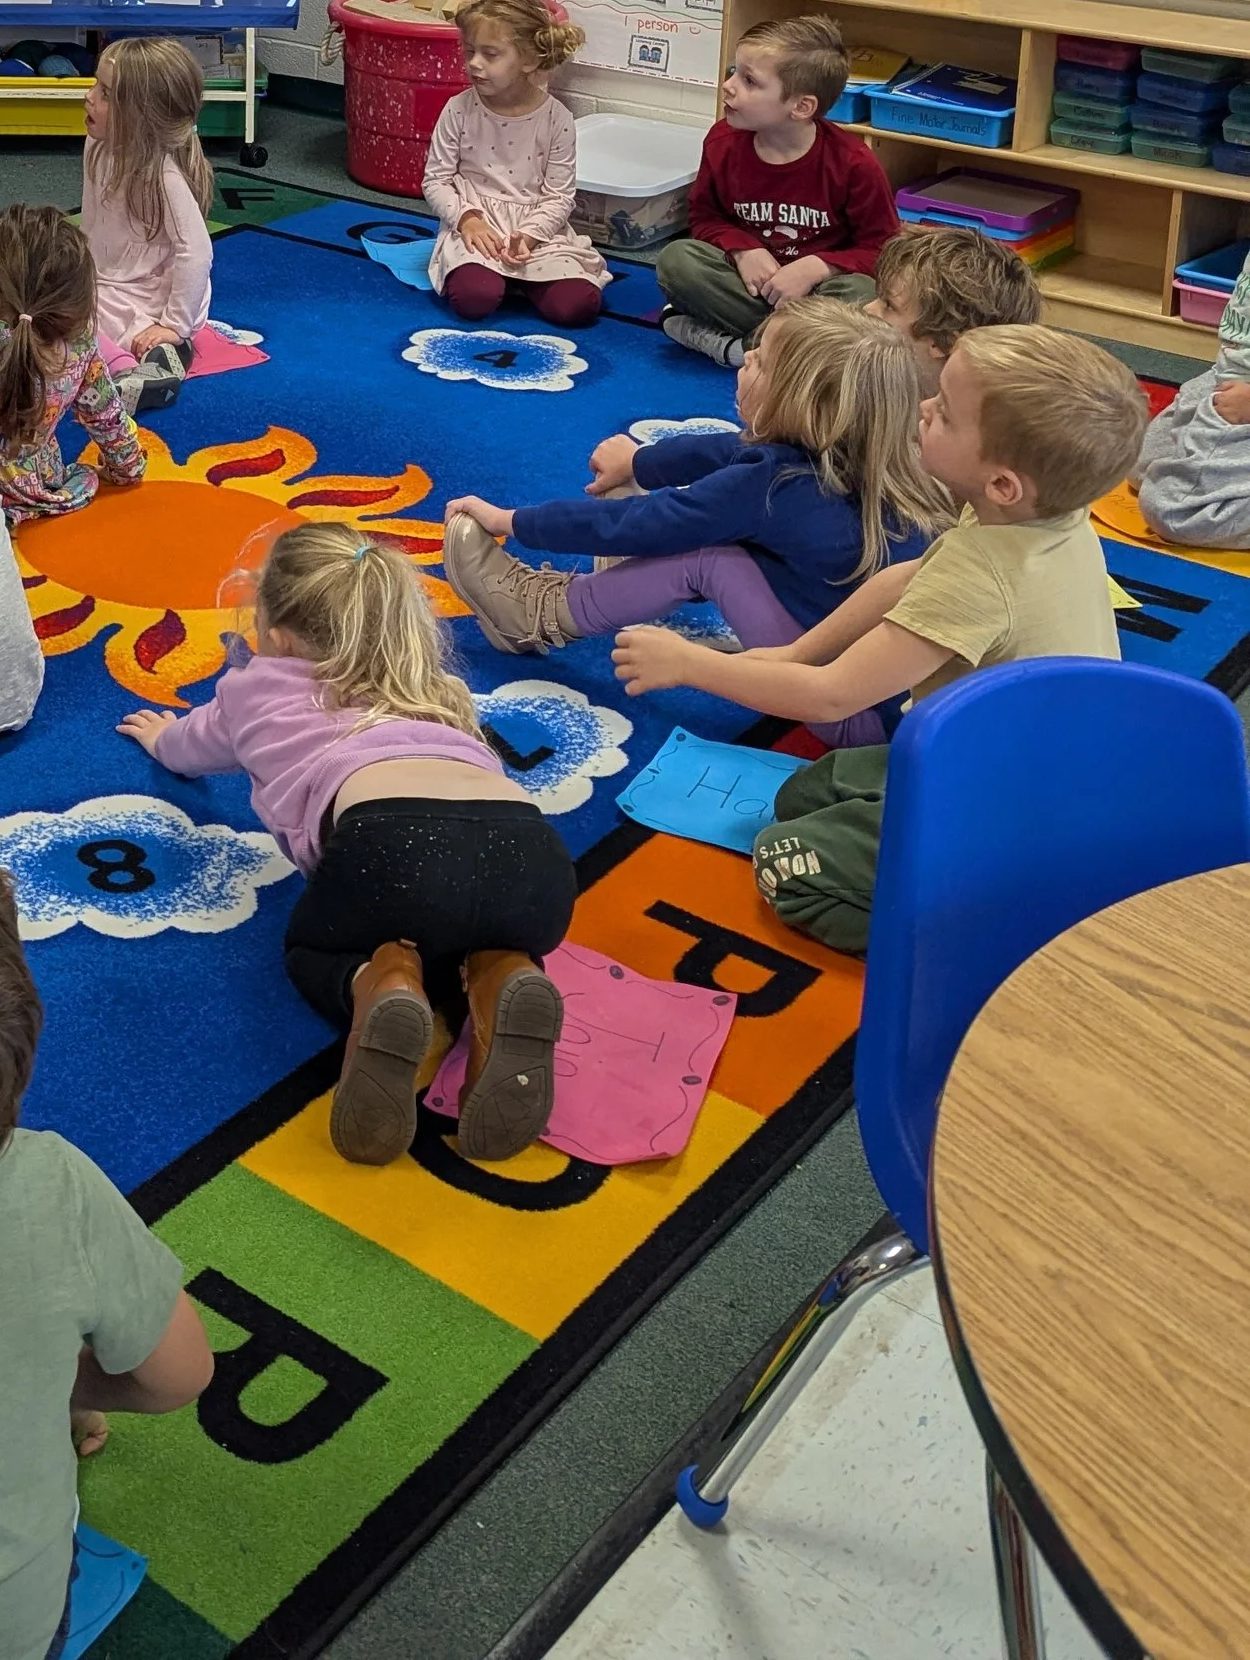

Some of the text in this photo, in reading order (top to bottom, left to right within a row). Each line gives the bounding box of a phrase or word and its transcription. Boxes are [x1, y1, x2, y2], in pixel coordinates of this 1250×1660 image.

[637, 18, 679, 33] person
[891, 106, 988, 137] Fine Motor Journals
[733, 201, 831, 229] TEAM SANTA
[472, 348, 520, 371] 4
[76, 837, 156, 894] 8
